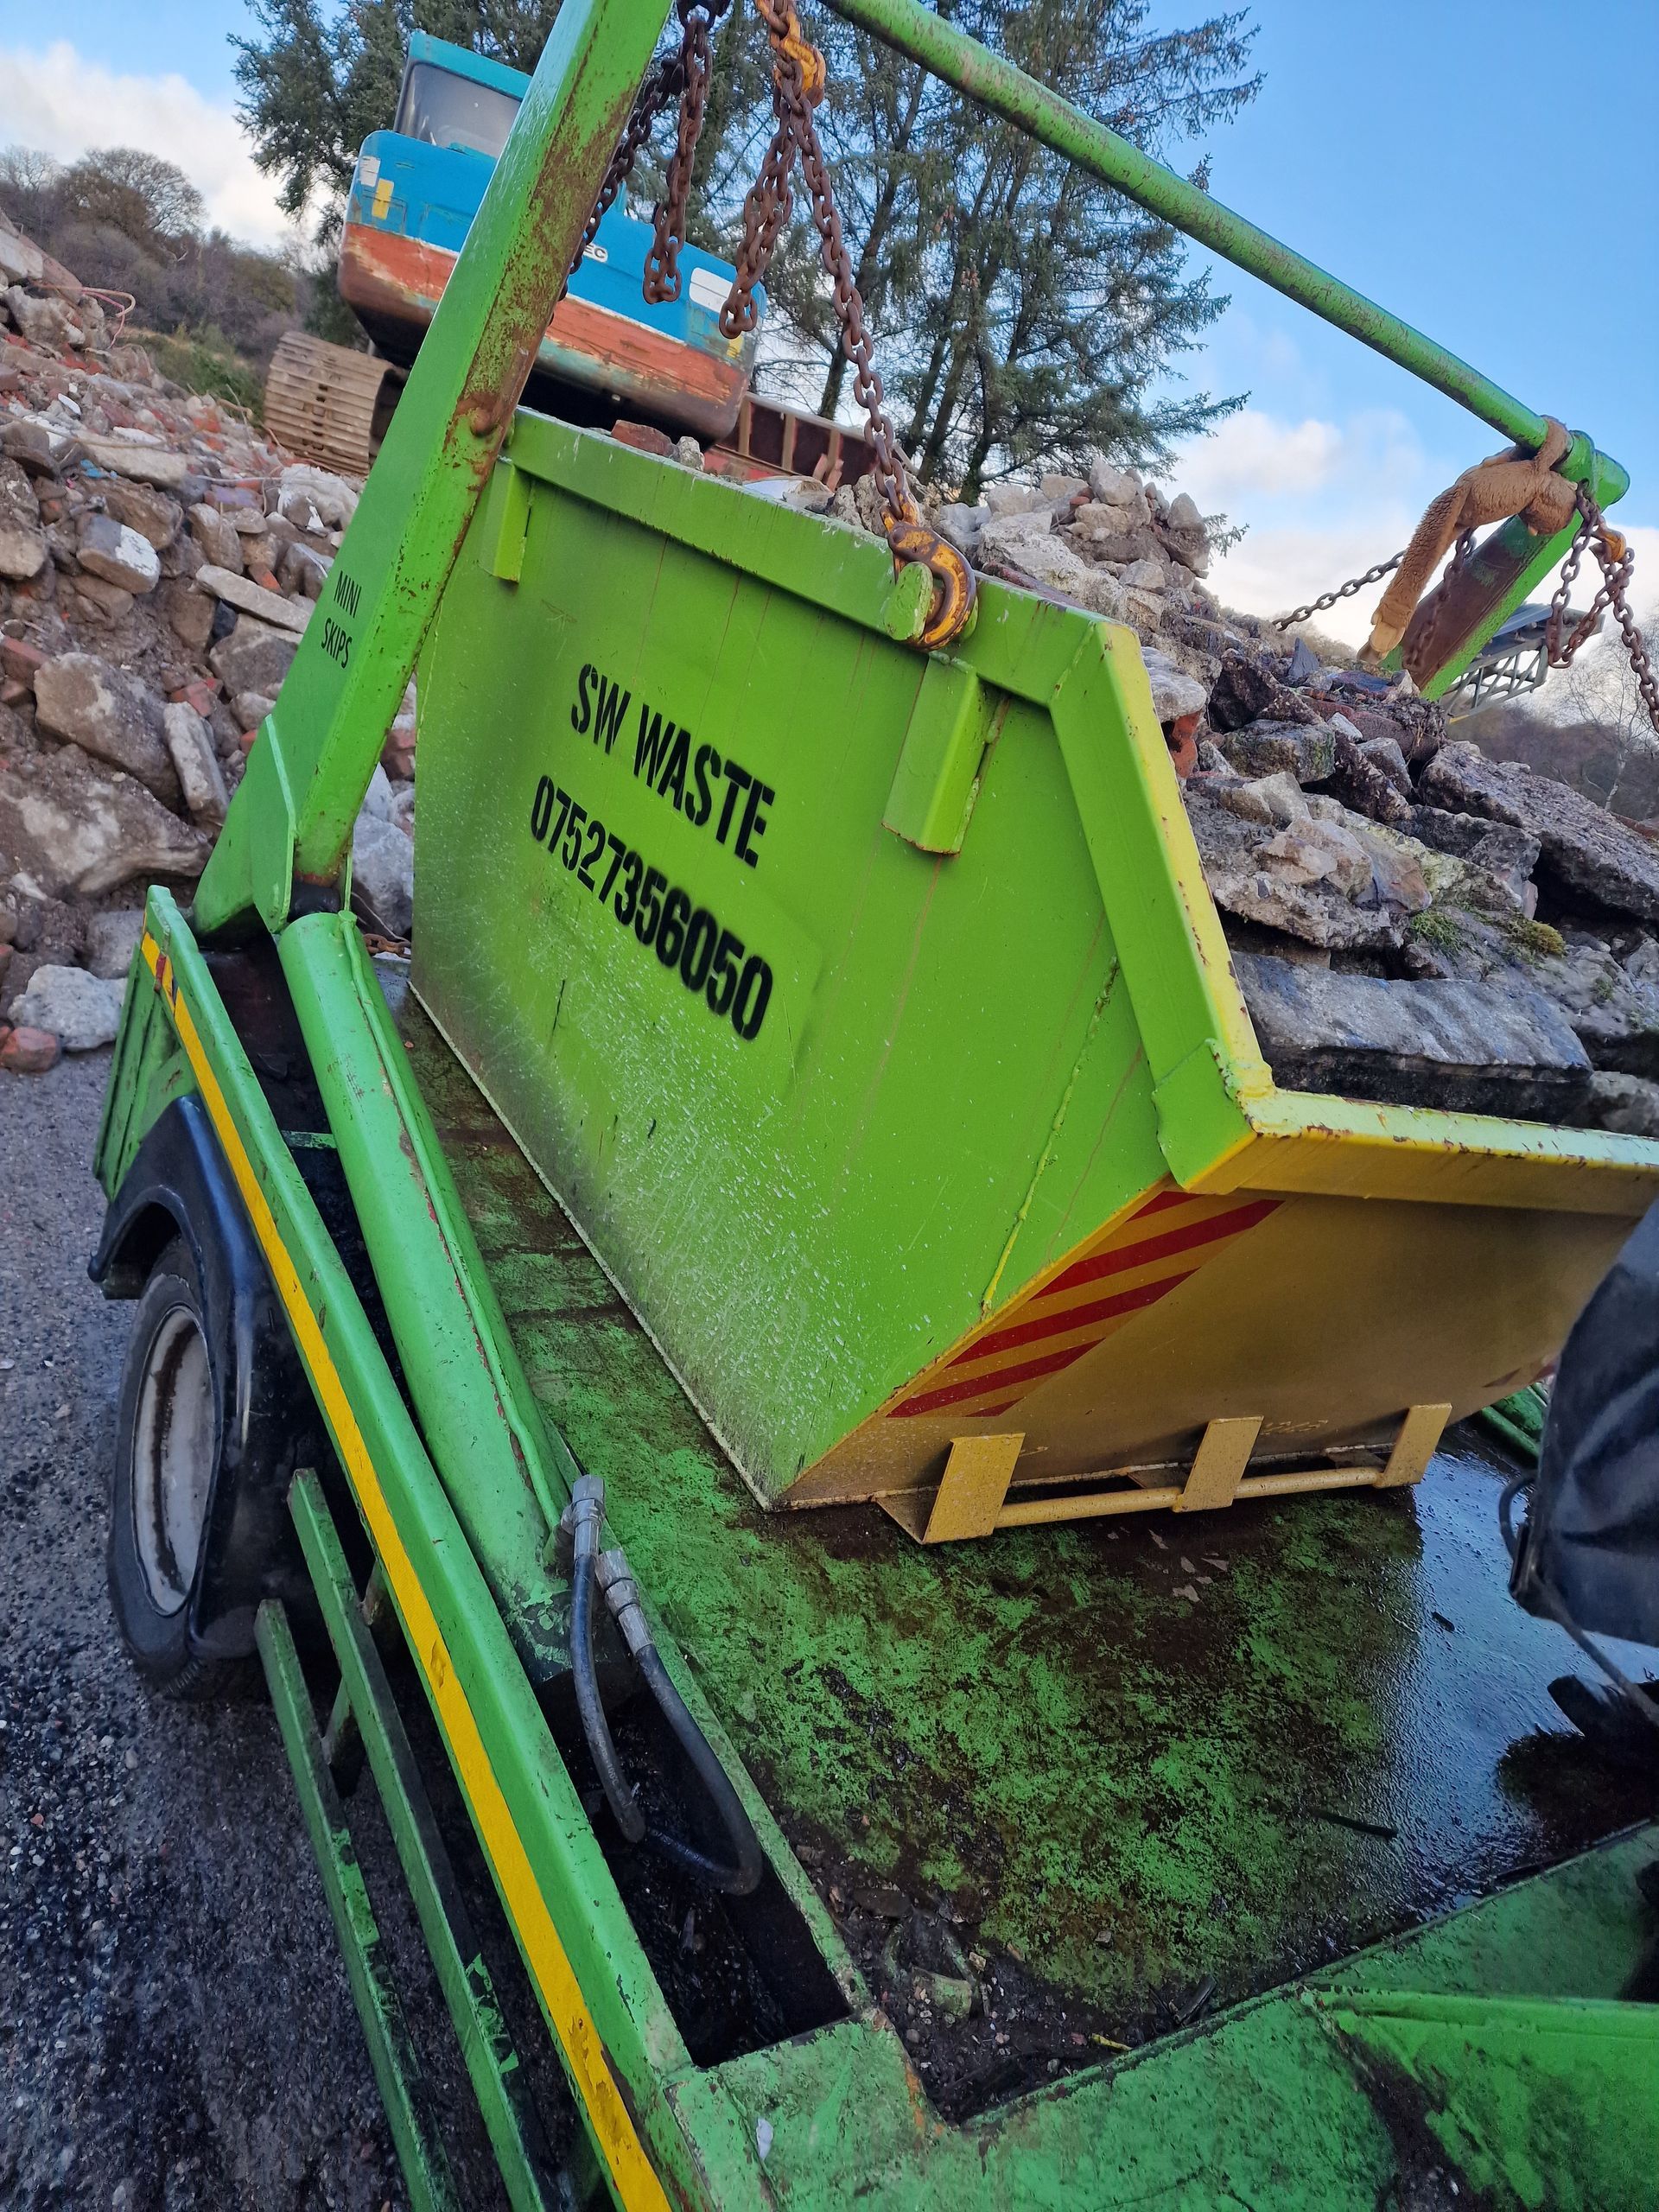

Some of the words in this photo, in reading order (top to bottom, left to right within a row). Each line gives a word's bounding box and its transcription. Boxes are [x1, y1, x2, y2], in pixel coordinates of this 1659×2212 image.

[321, 617, 353, 669] SKIPS
[334, 570, 362, 619] MINI
[571, 663, 632, 755] SW
[633, 702, 775, 869] WASTE
[530, 775, 773, 1040] 07527356050
